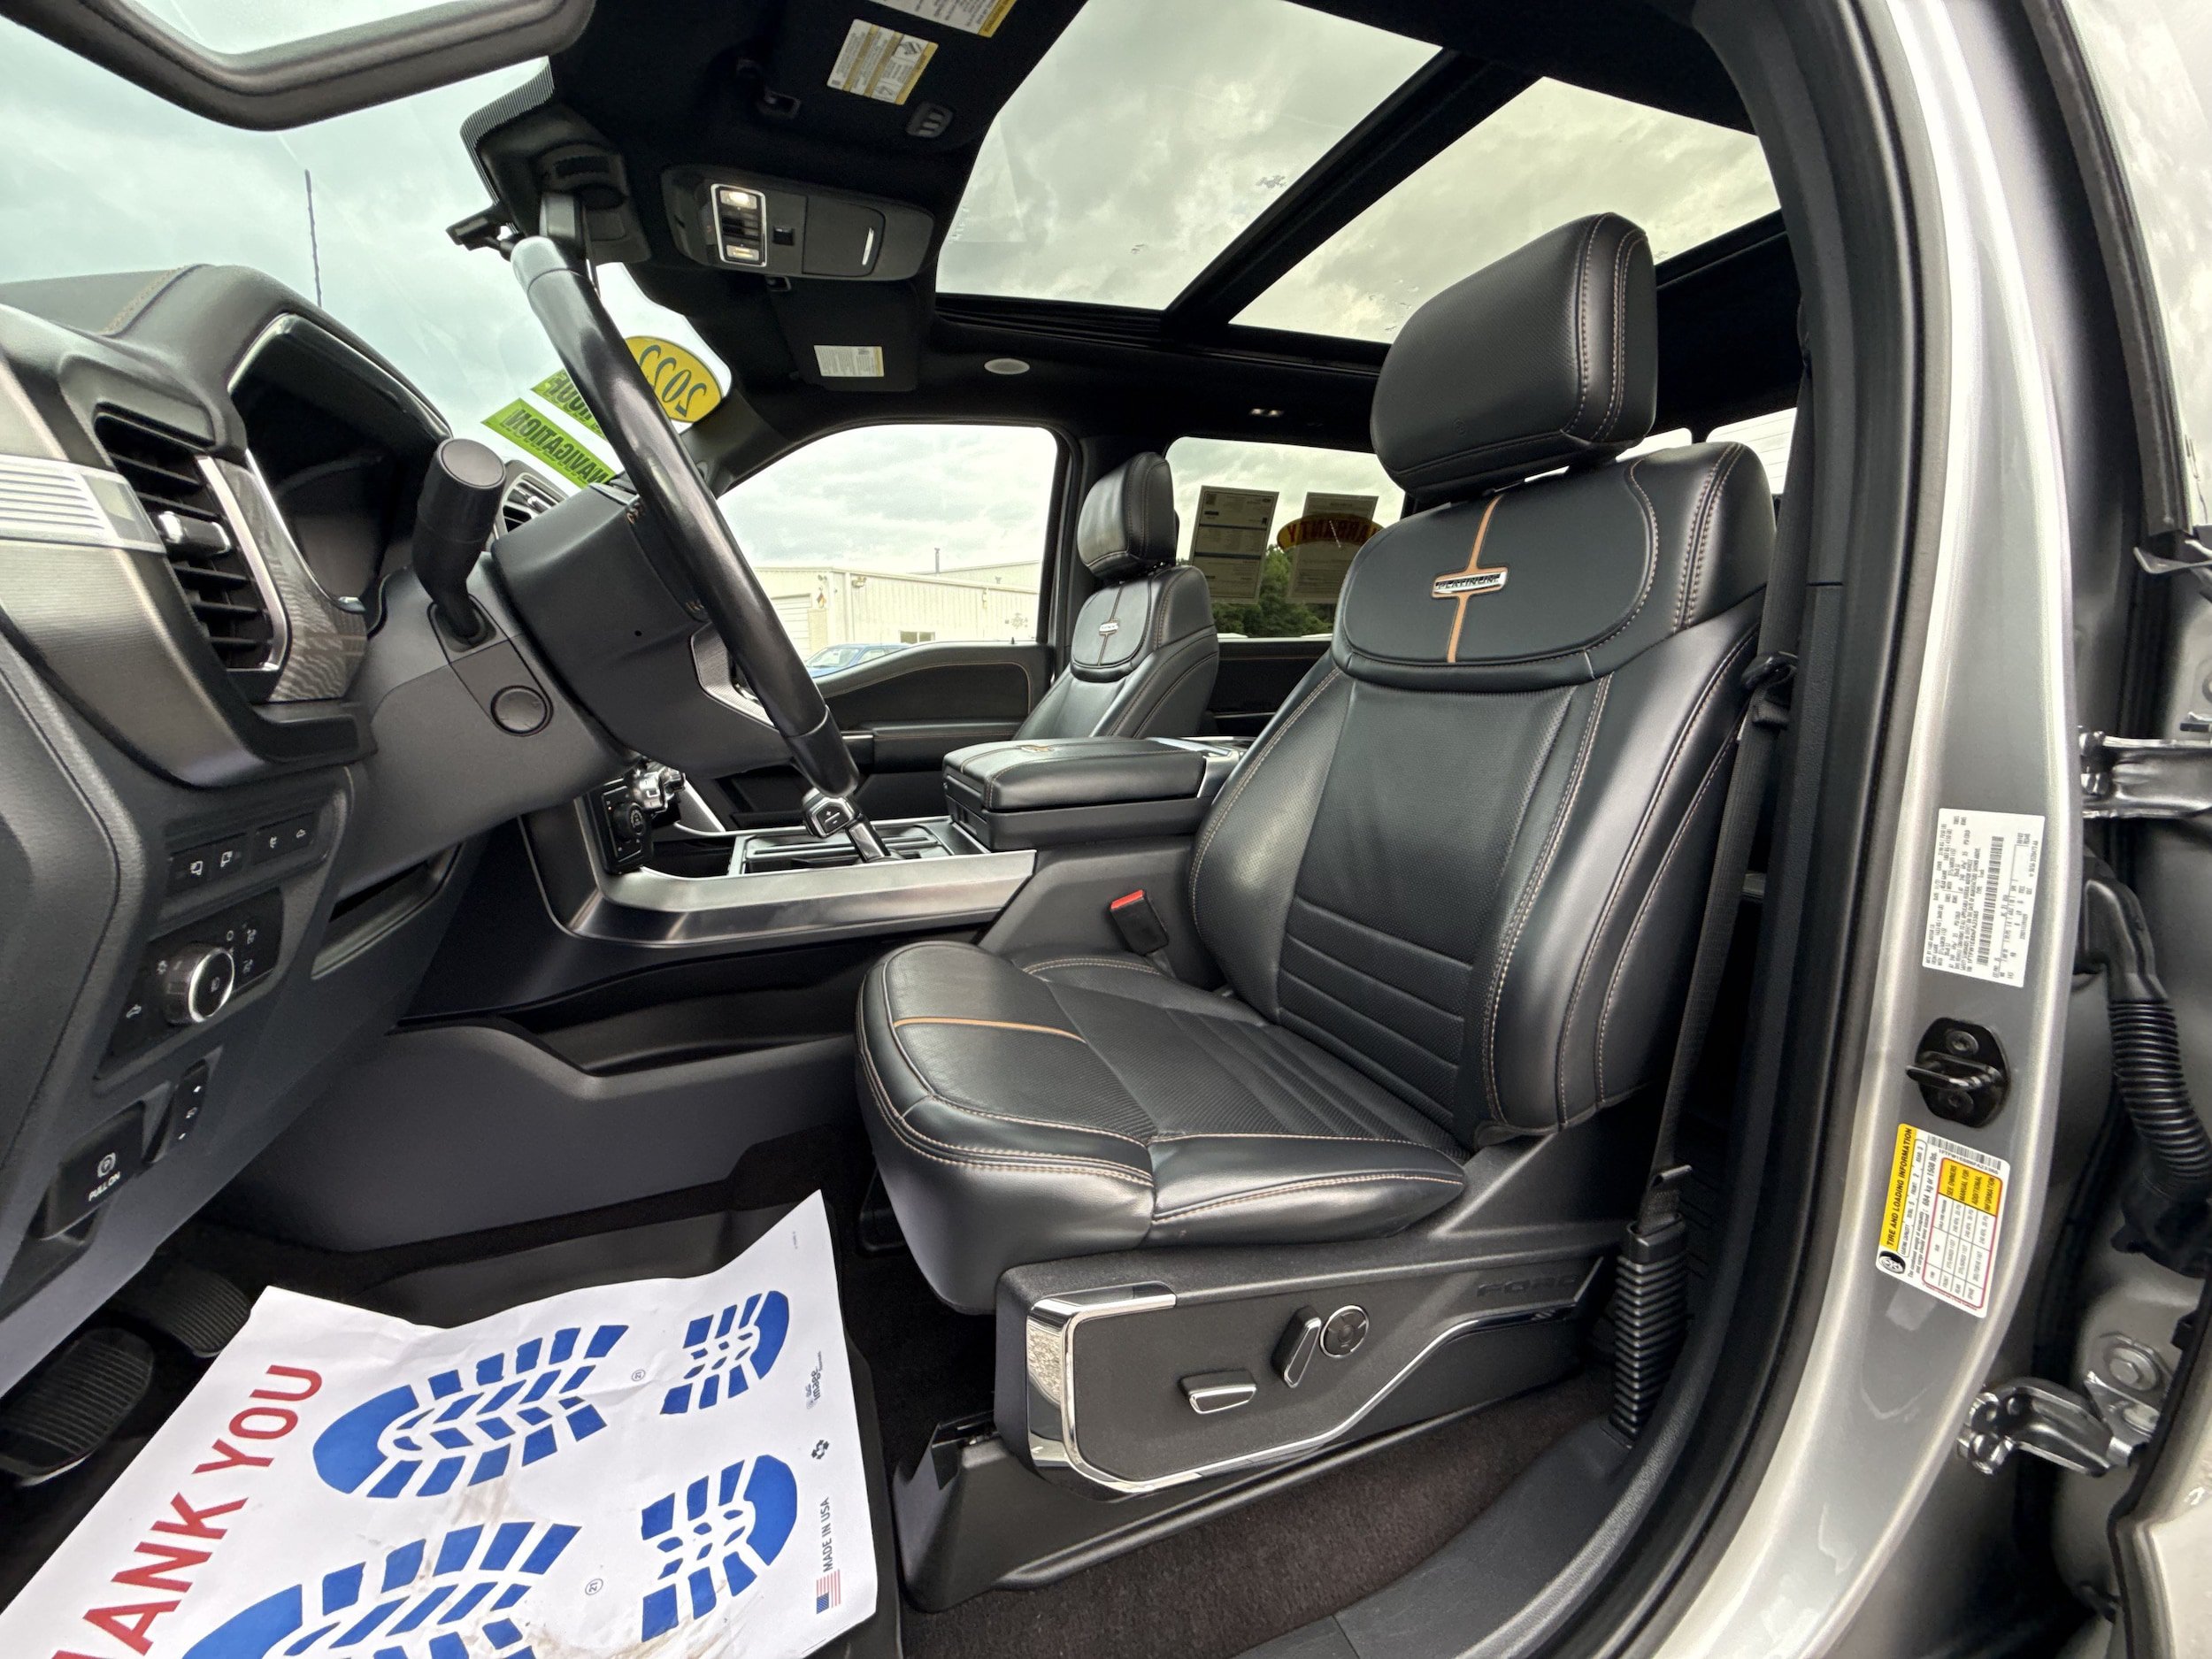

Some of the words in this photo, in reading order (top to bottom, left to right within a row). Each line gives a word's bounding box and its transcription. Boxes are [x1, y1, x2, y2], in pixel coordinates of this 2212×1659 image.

[1897, 1126, 1912, 1179] INFORMATION
[1947, 1164, 1957, 1187] OWNERS
[1961, 1168, 1970, 1180] FOR
[1892, 1179, 1904, 1211] LOADING
[1924, 1184, 1933, 1194] kg
[1958, 1179, 1968, 1202] MANUAL
[1970, 1174, 1982, 1205] ADDITIONAL
[1984, 1176, 1995, 1211] INFORMATION
[1889, 1211, 1898, 1228] AND
[1886, 1228, 1895, 1247] TIRE
[50, 1492, 250, 1659] ANK
[191, 1364, 323, 1475] YOU
[819, 1496, 831, 1523] USA
[821, 1523, 832, 1538] IN
[822, 1538, 833, 1573] MADE
